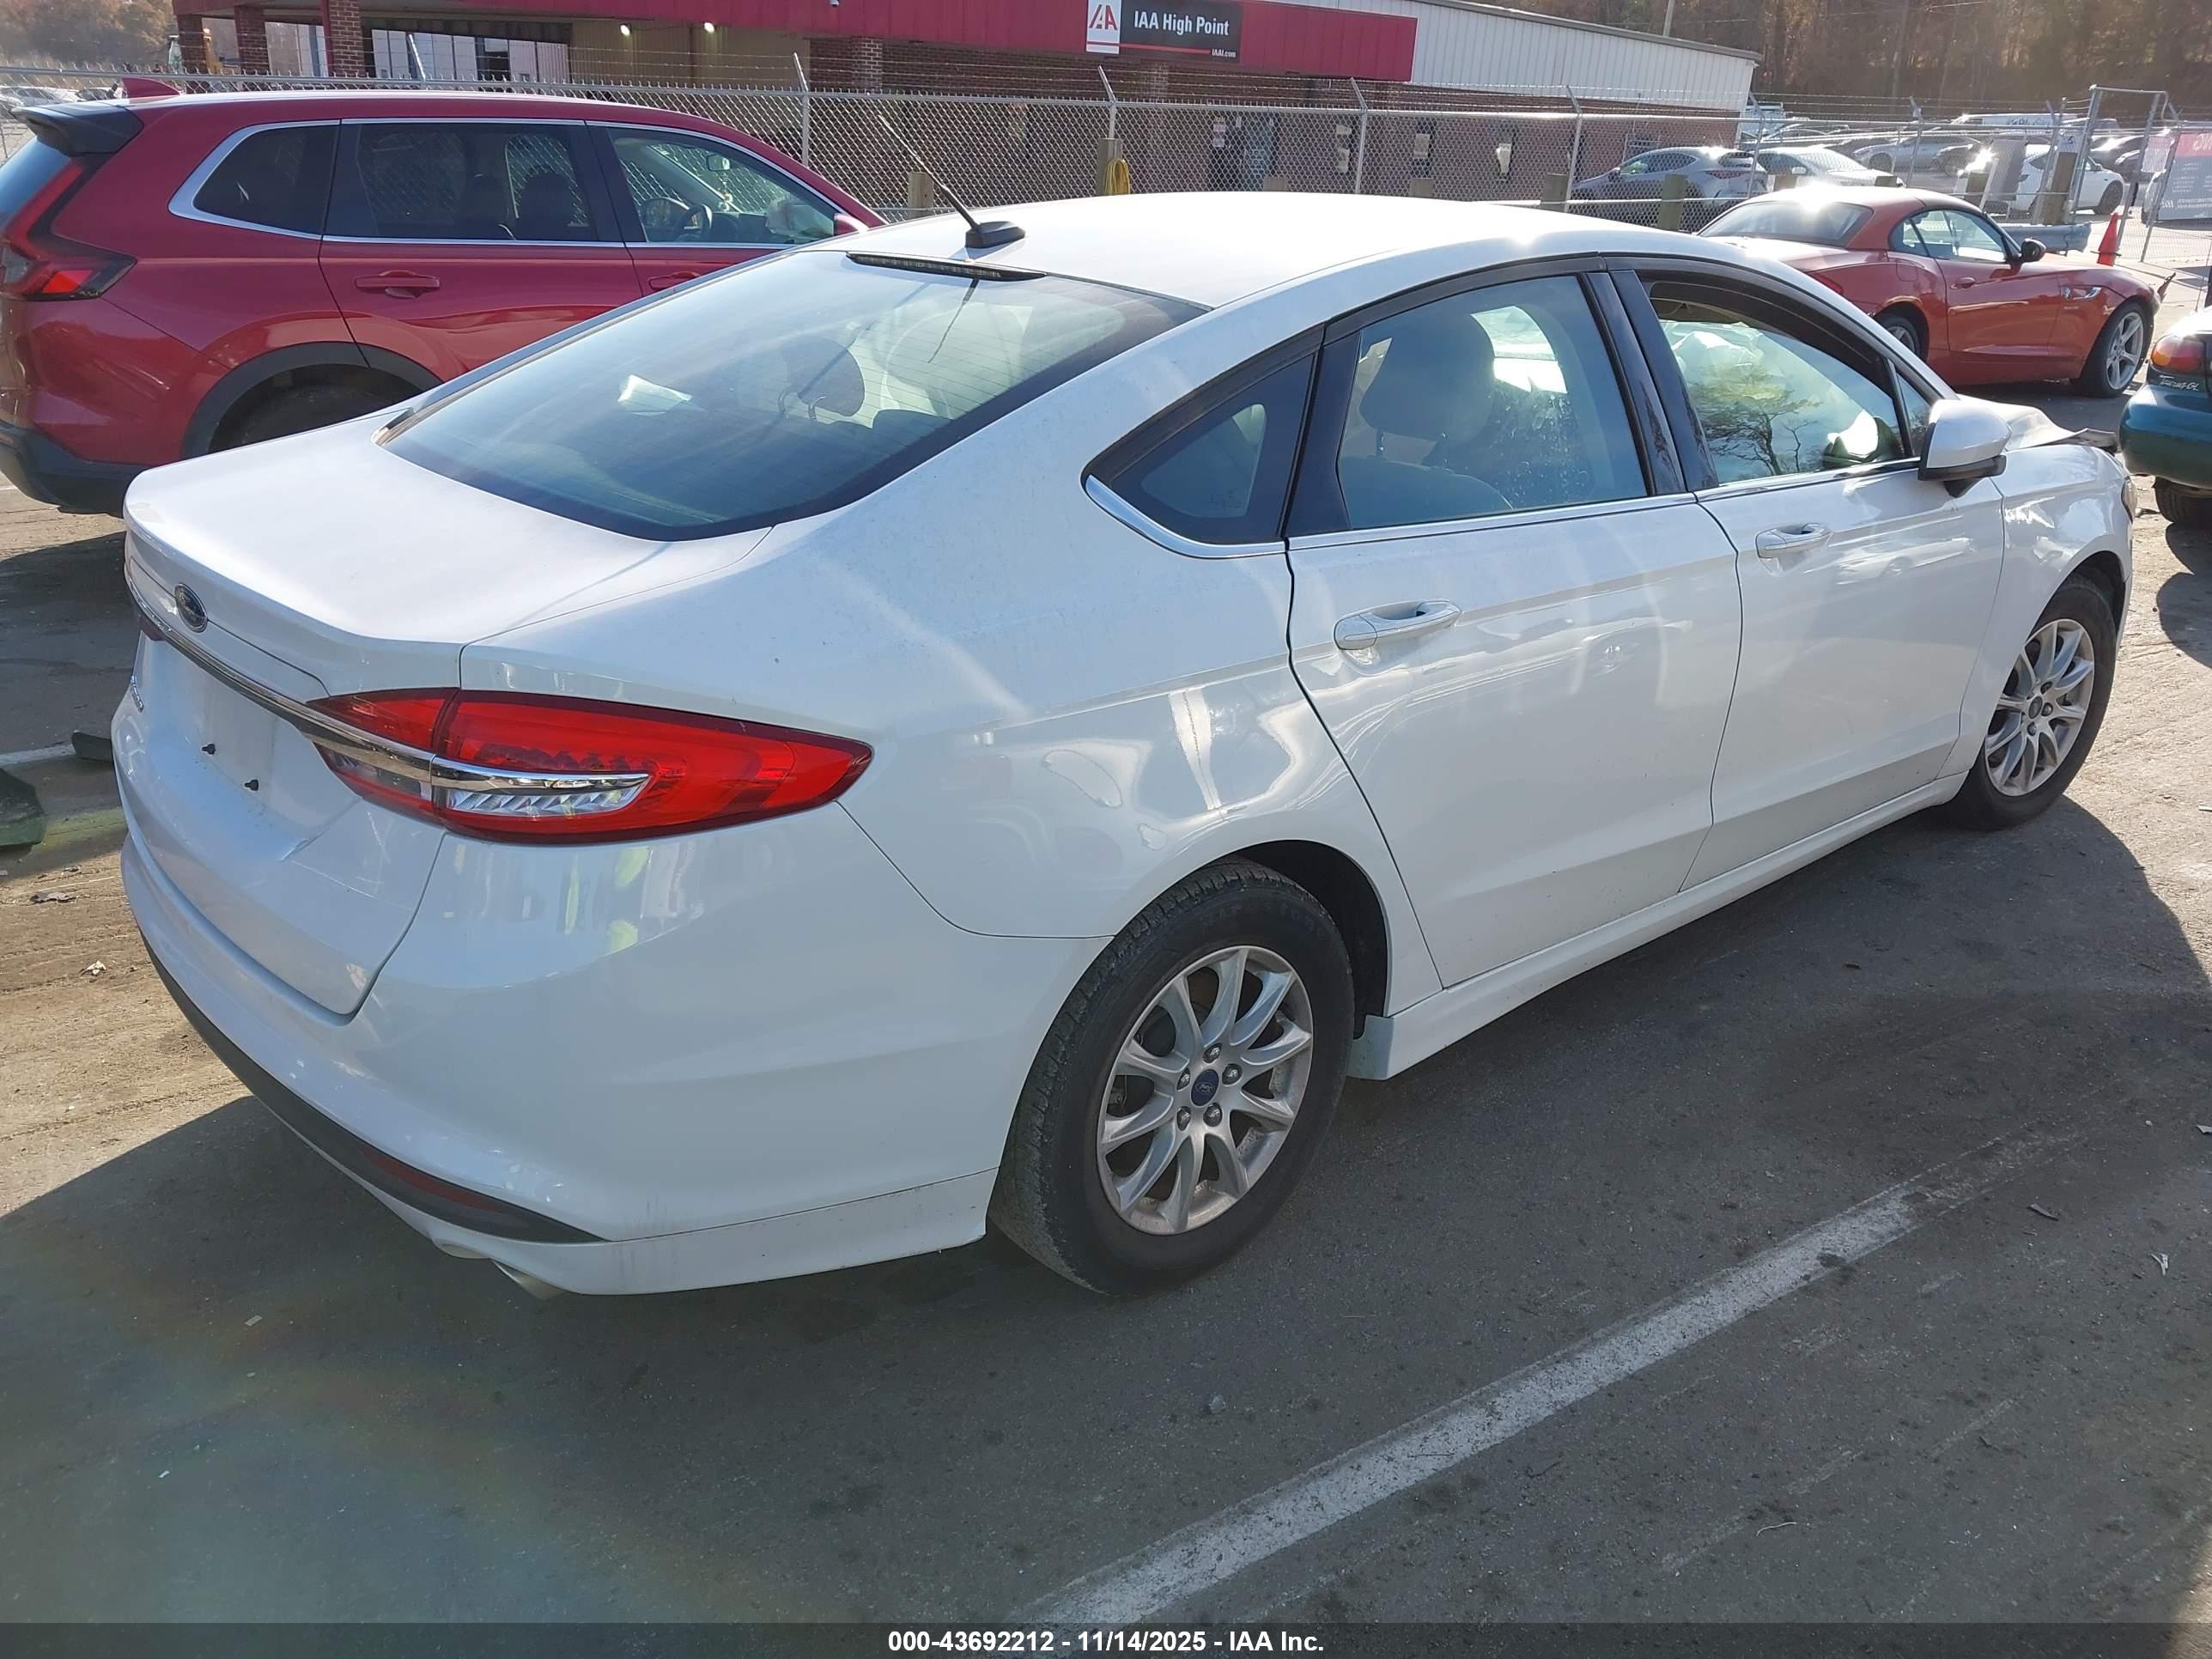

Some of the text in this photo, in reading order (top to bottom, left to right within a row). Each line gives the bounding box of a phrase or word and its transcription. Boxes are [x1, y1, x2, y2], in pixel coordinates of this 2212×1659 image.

[1133, 10, 1229, 35] IAA High Point
